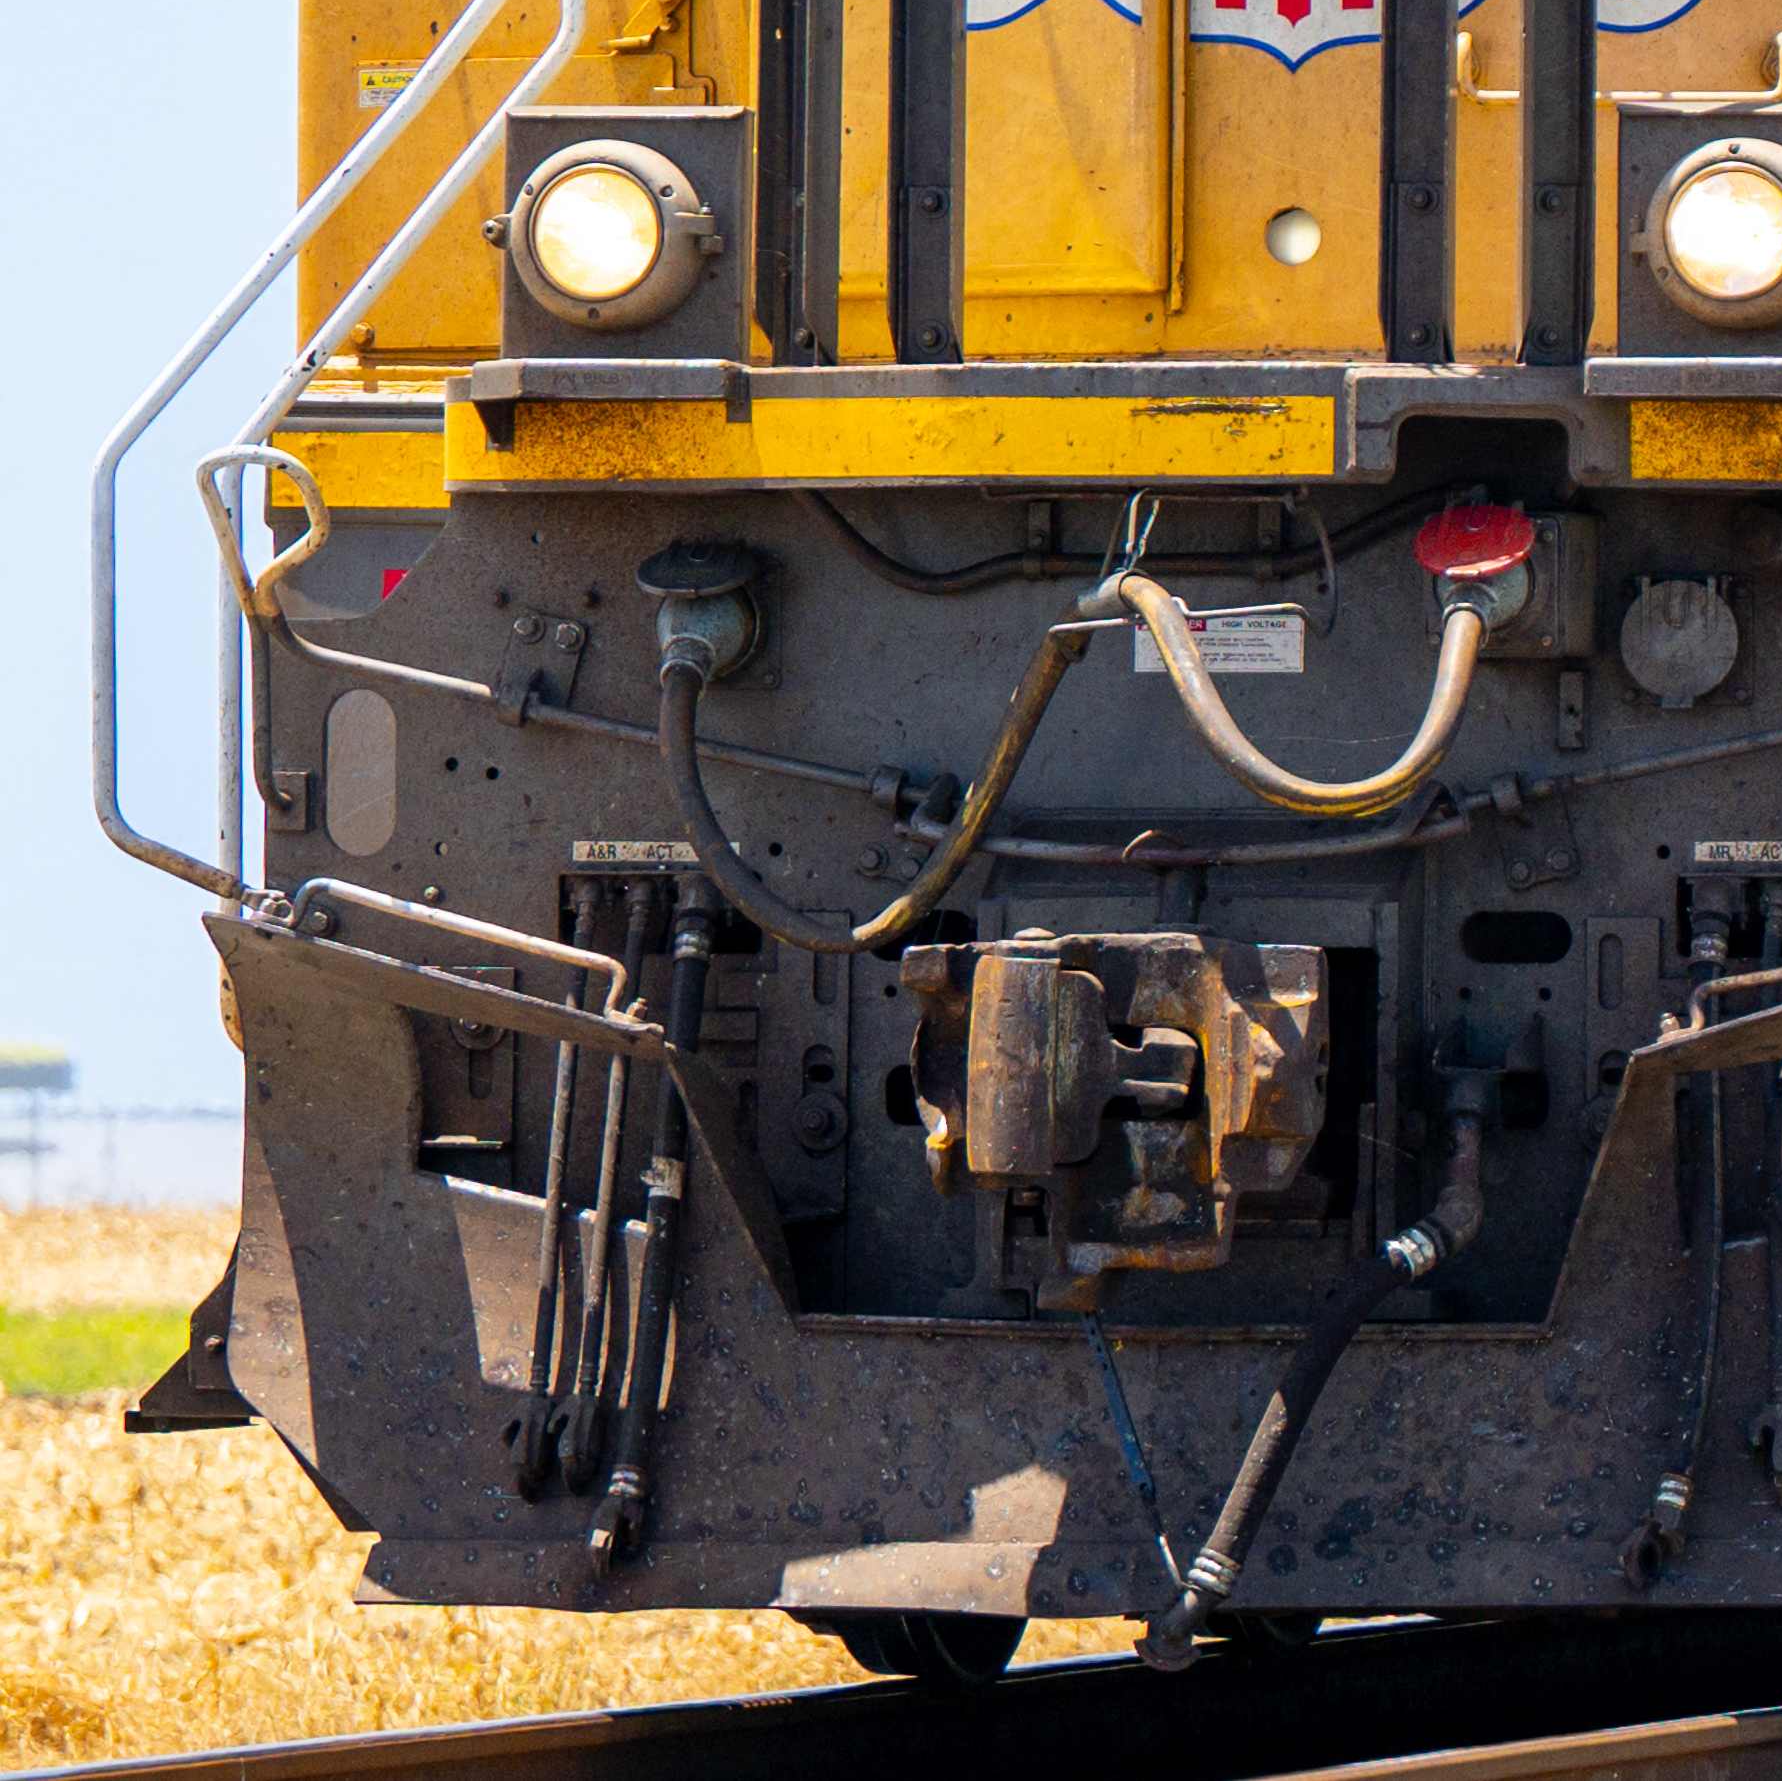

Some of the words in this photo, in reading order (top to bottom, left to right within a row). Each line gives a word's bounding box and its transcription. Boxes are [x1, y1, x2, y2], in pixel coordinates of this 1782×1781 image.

[1222, 620, 1243, 628] HIGH
[1248, 620, 1287, 628] VOLTAGE
[587, 844, 617, 859] A&R
[647, 844, 675, 860] ACT
